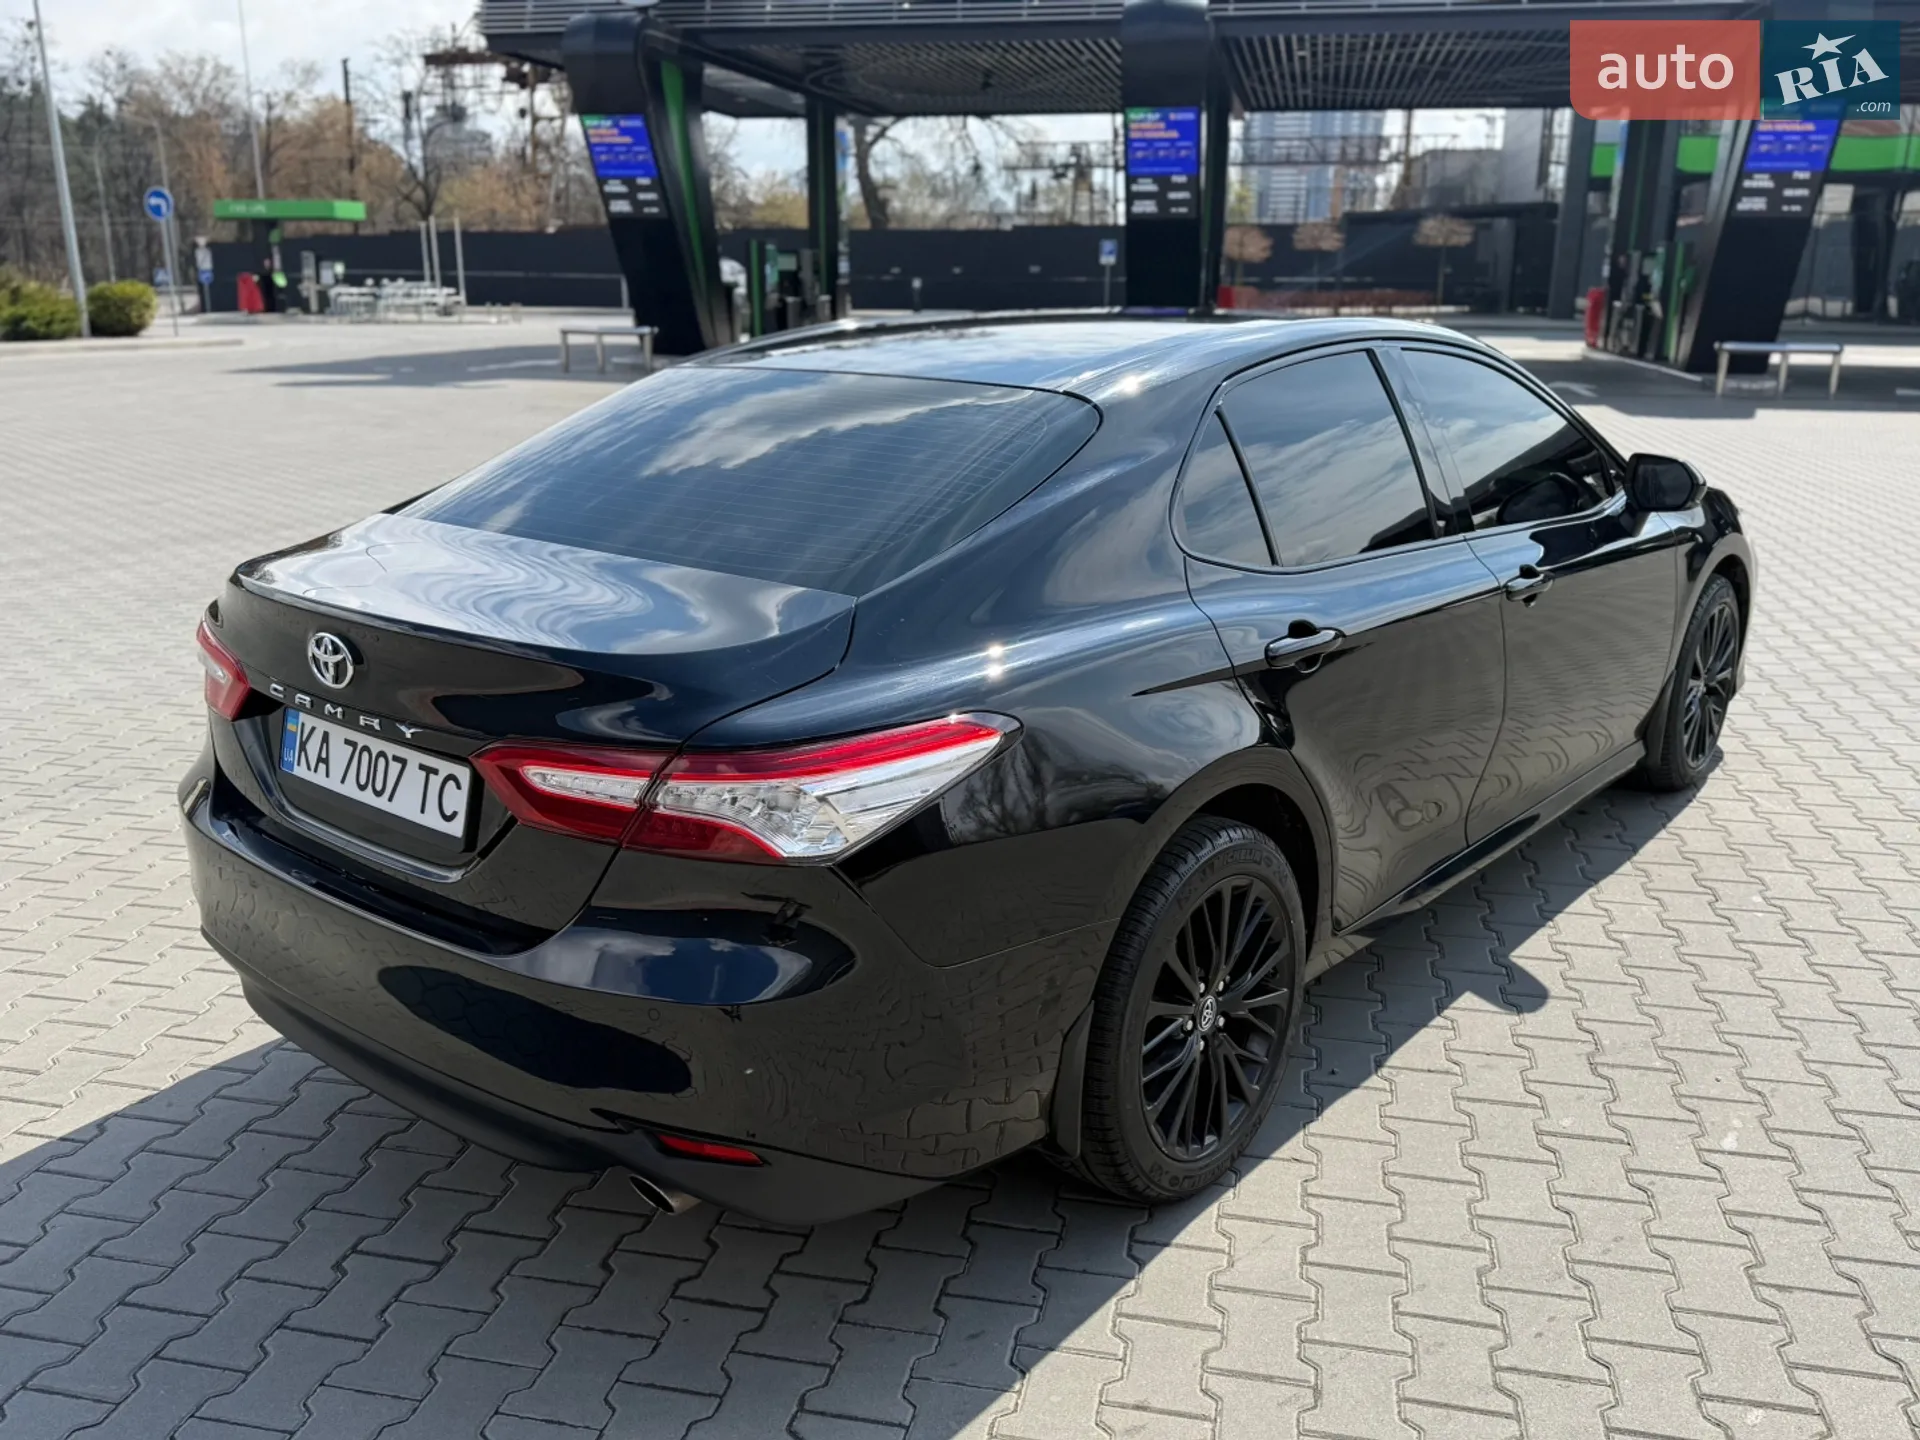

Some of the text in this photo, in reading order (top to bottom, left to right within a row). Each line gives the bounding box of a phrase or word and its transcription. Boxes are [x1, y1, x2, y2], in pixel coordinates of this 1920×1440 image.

[269, 683, 424, 739] CAMRY
[283, 747, 294, 763] UA
[297, 721, 462, 823] KA 7007 TC
